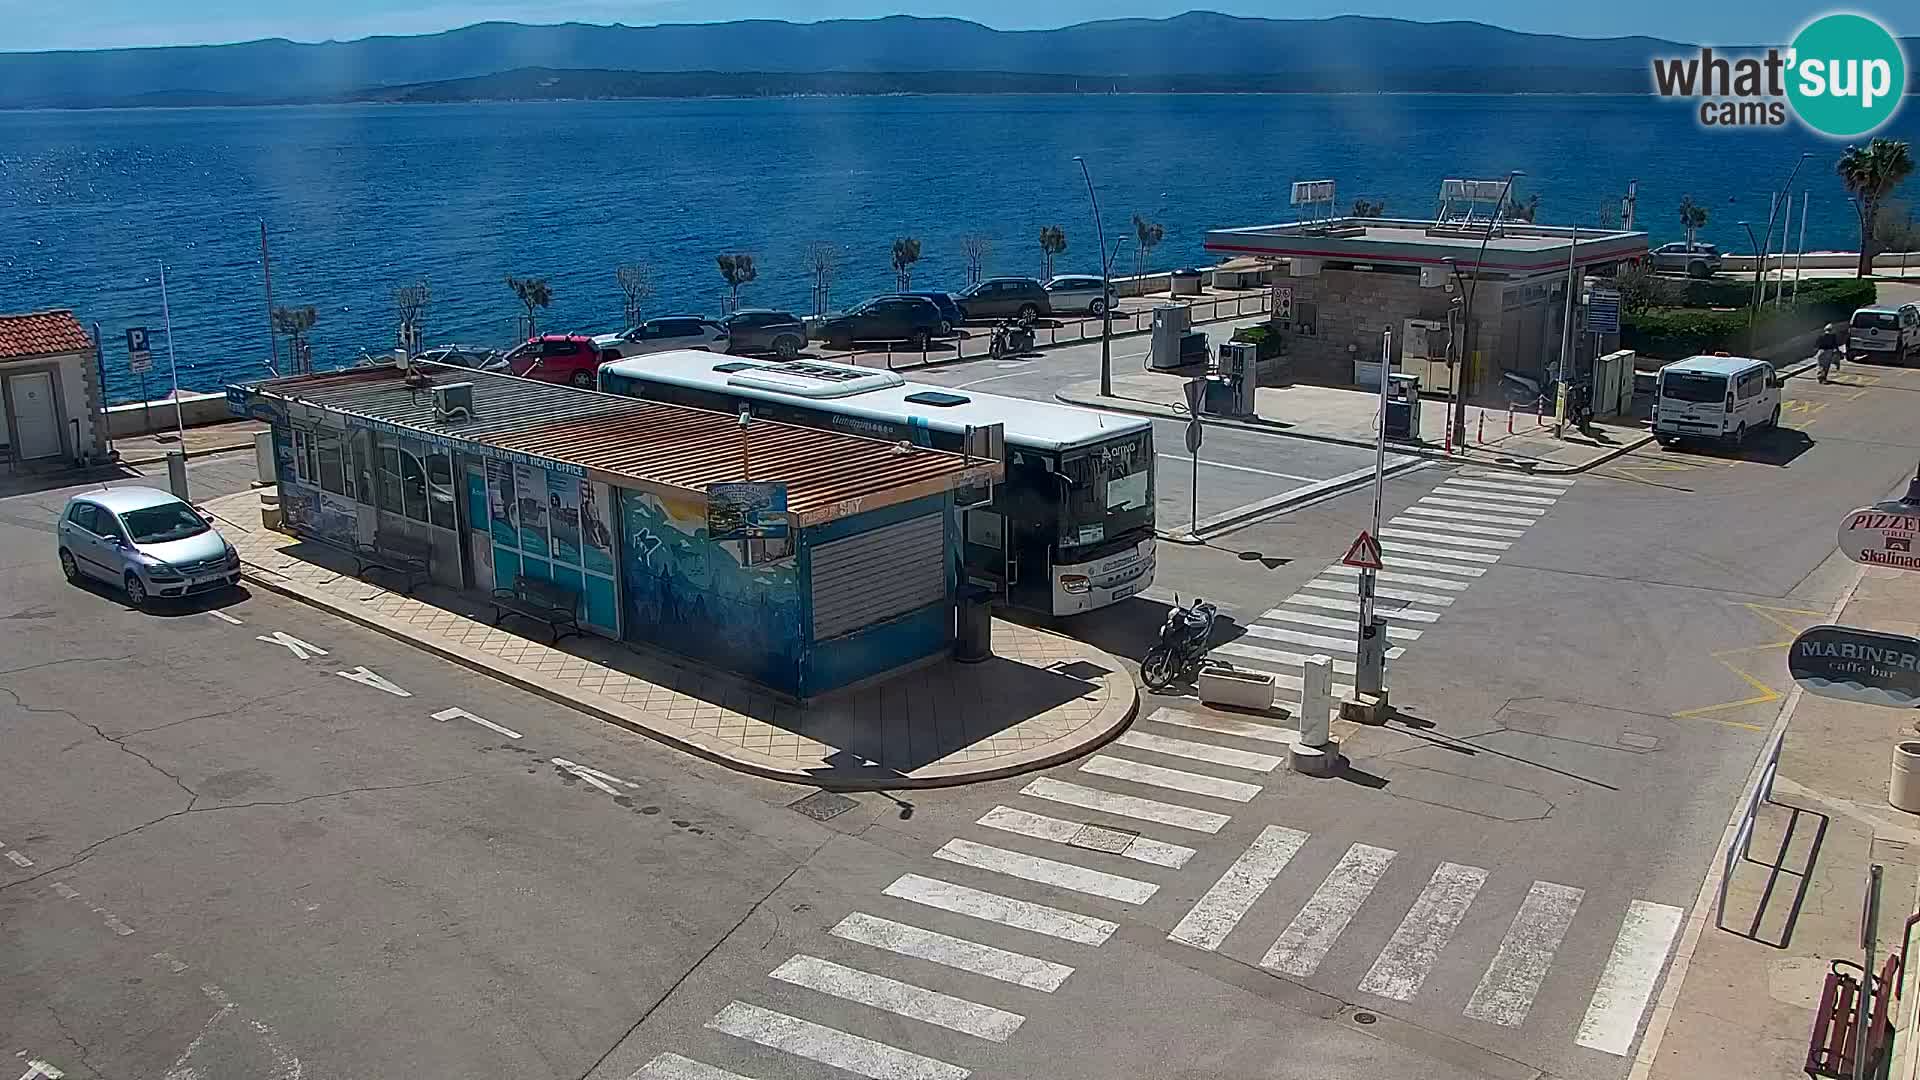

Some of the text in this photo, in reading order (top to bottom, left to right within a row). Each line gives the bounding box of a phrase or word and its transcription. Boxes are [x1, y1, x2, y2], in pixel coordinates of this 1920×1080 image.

[131, 330, 144, 349] P
[480, 446, 494, 457] BUS
[495, 448, 527, 463] STATION
[529, 456, 554, 470] TICKET
[556, 462, 584, 476] OFFICE
[1850, 514, 1920, 533] PIZZE
[1829, 661, 1897, 679] caffe bar
